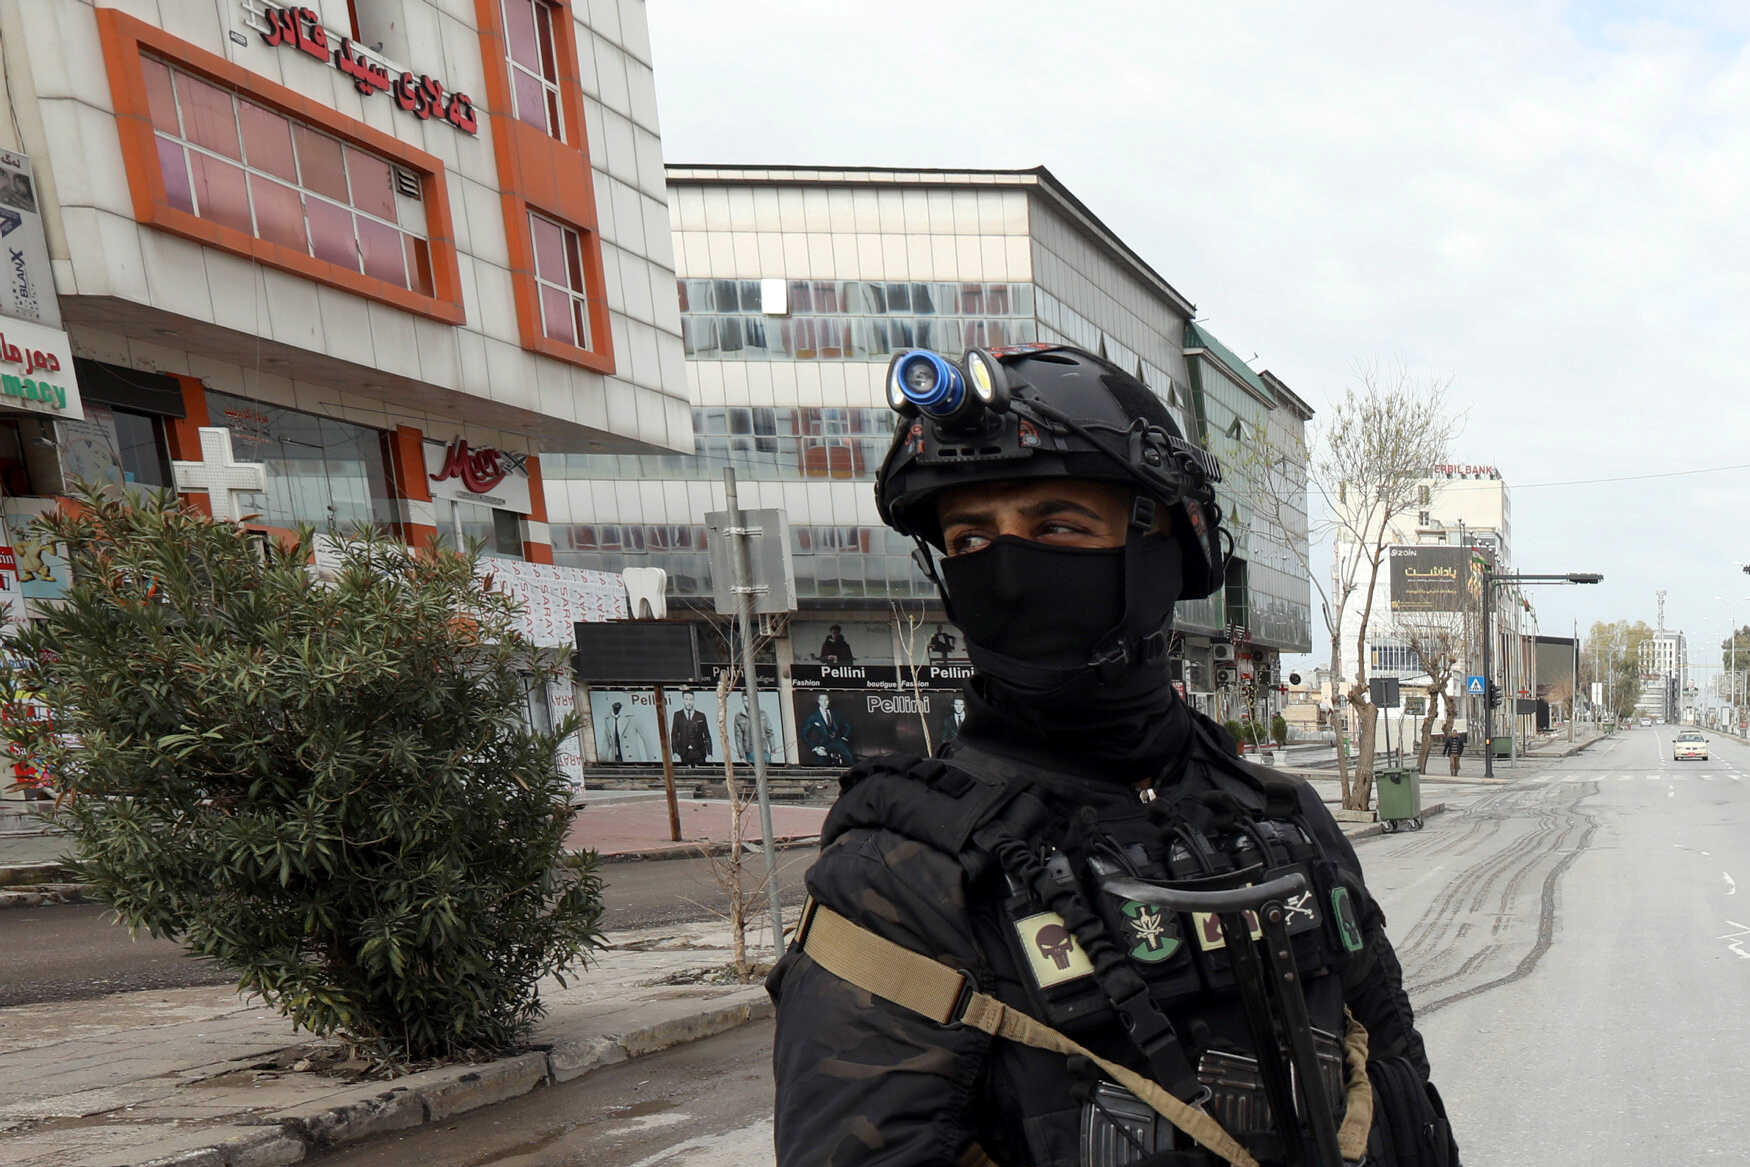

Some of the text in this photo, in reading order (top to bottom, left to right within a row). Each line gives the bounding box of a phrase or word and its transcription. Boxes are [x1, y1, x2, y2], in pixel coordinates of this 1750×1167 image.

[259, 6, 330, 63] قادر
[0, 332, 60, 375] دەرما
[0, 374, 66, 408] macy
[1434, 465, 1492, 474] ERBIL BANK
[560, 585, 574, 639] SARAY
[821, 666, 866, 678] Pellini
[930, 666, 975, 679] Pellini
[792, 679, 821, 687] Fashion
[901, 679, 929, 687] Fasion
[631, 694, 672, 706] Pelli
[867, 695, 931, 714] Pellini
